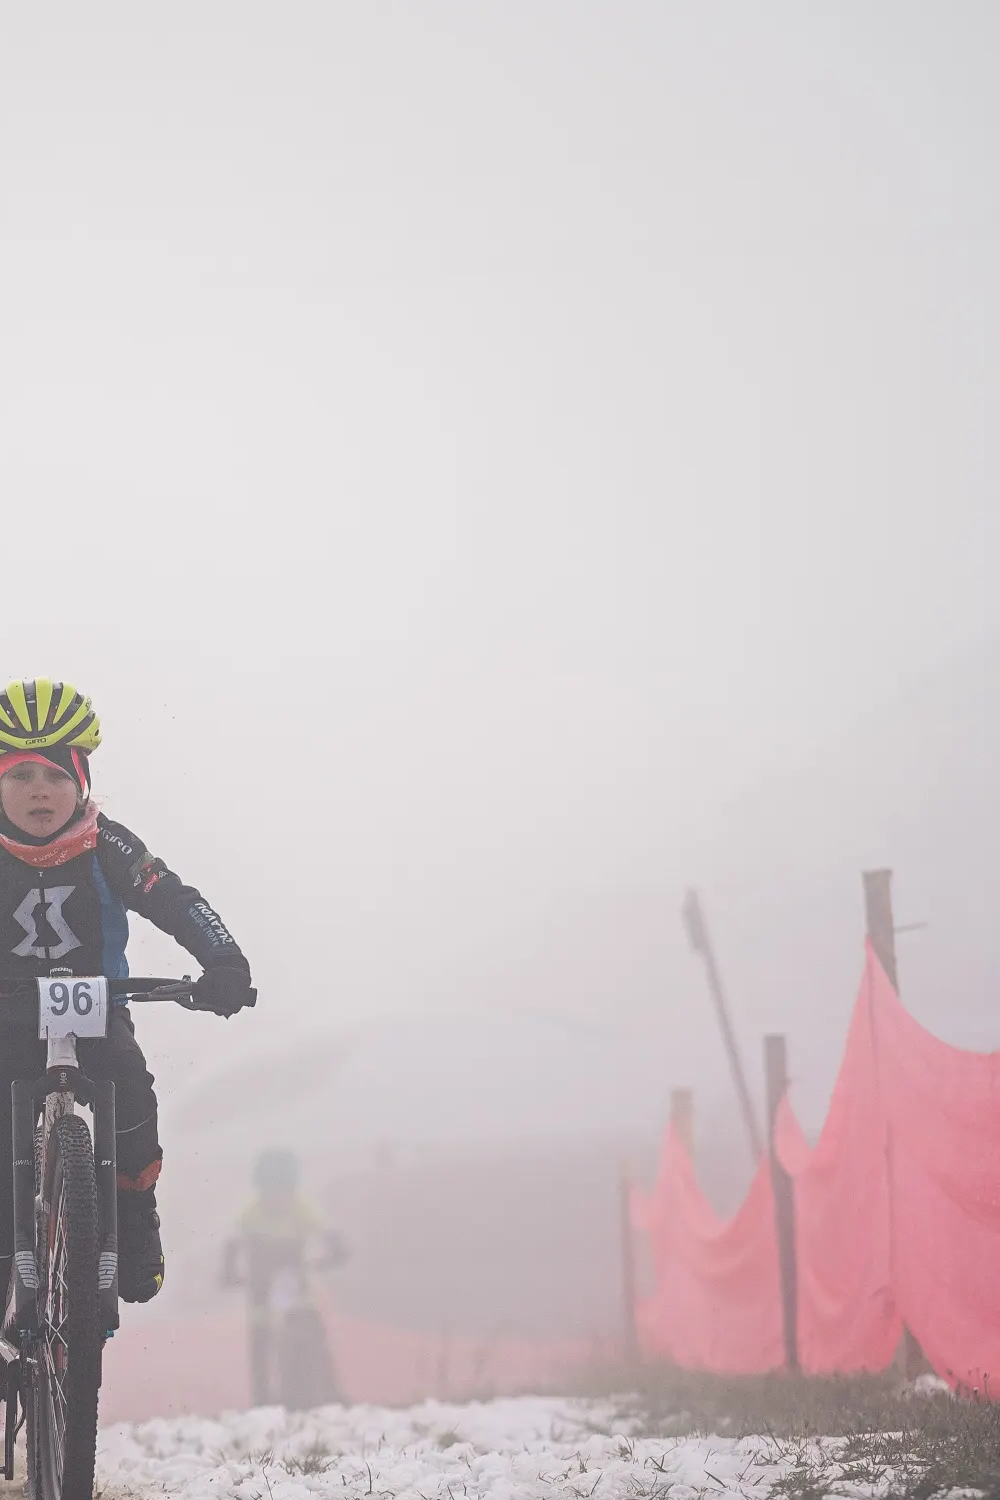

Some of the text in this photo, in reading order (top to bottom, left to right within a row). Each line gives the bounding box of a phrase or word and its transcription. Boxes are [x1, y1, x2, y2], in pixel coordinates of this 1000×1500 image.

[25, 738, 47, 746] GIRO
[102, 829, 133, 855] GIRO
[49, 982, 93, 1016] 96
